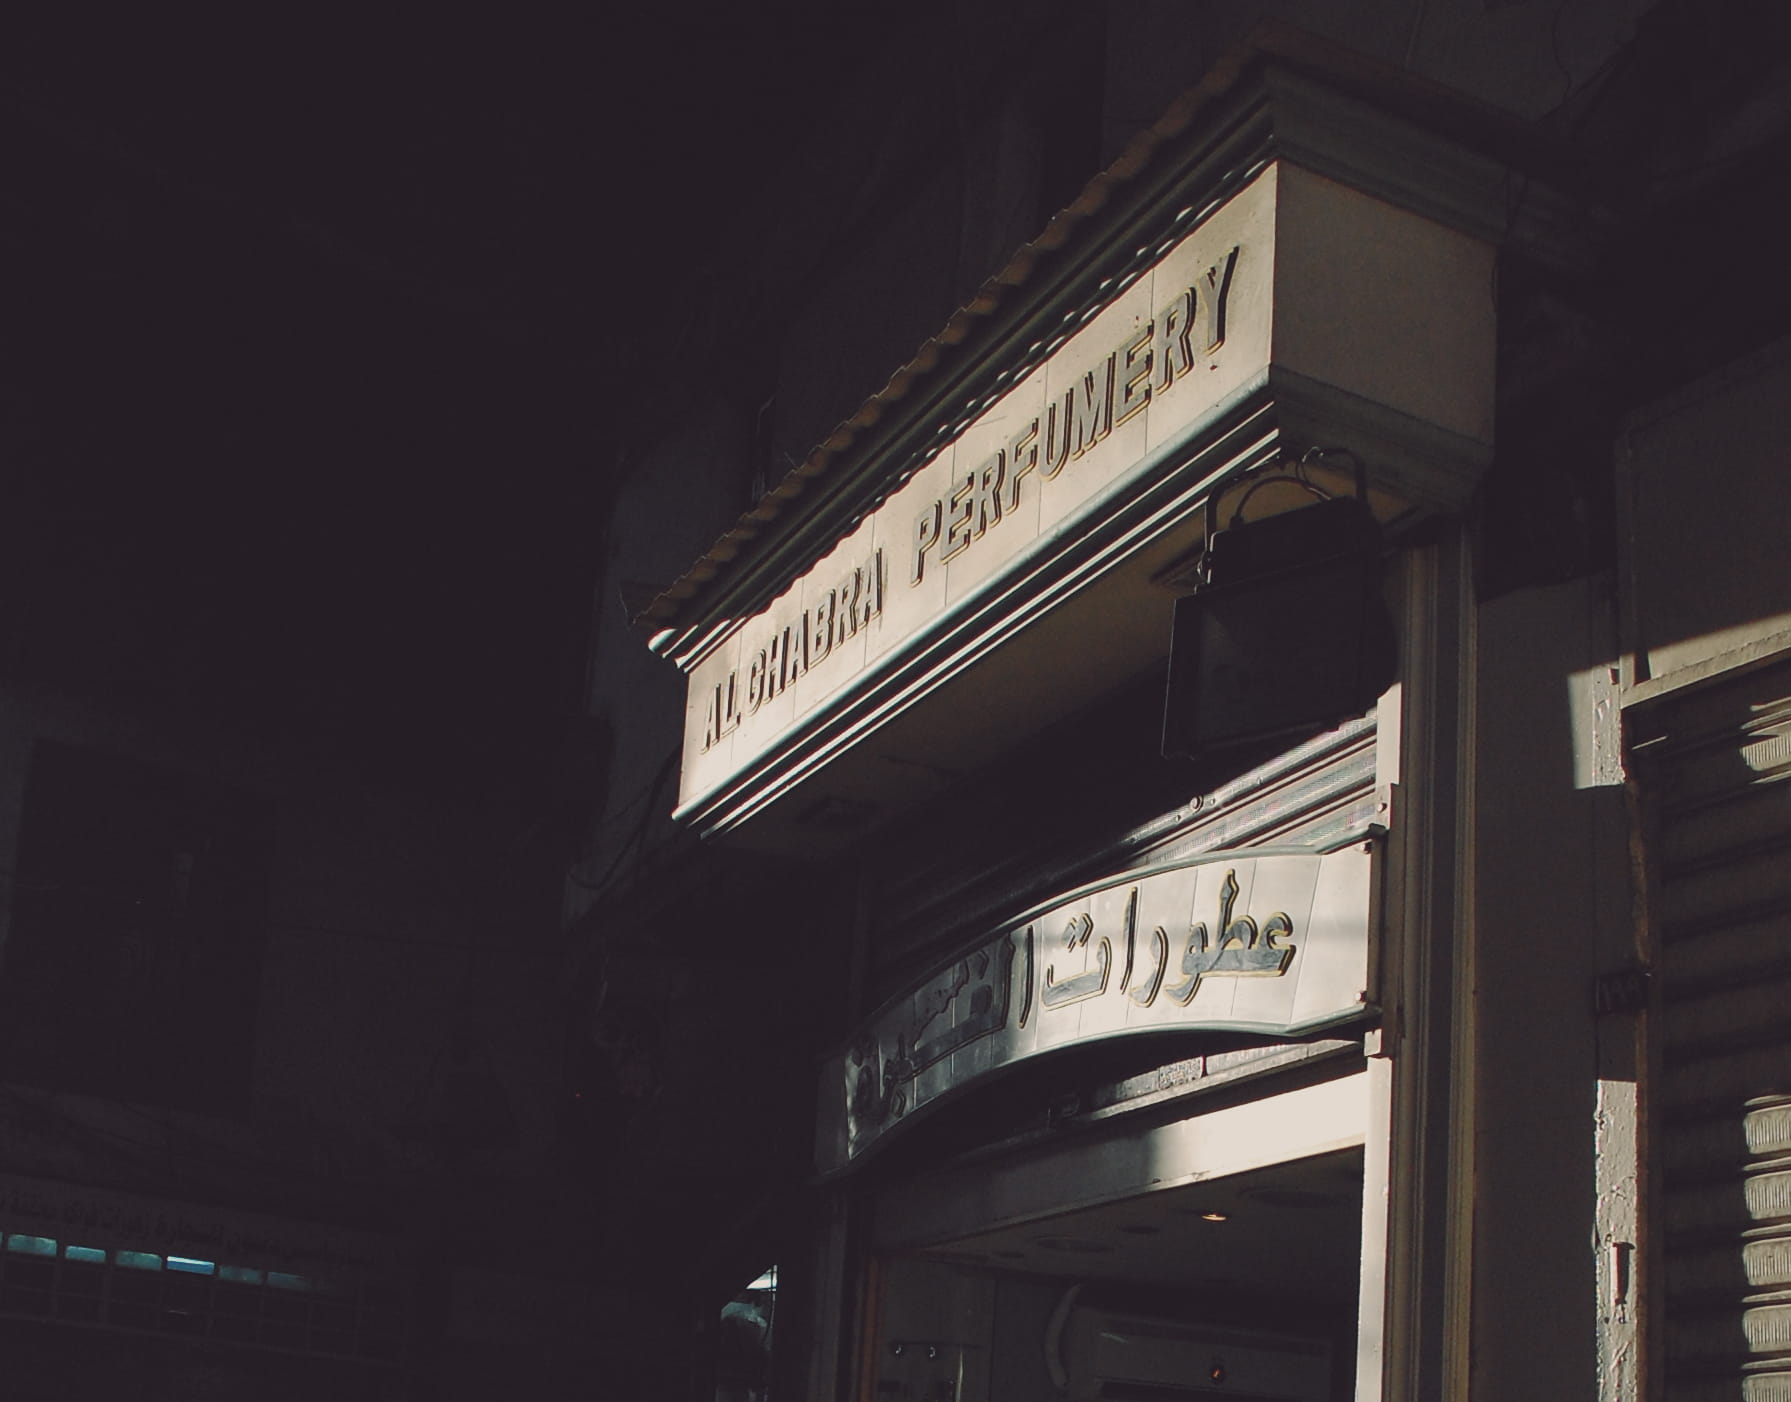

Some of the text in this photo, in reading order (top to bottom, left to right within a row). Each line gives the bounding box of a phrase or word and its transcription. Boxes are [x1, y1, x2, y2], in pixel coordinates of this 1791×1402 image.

[699, 245, 1240, 756] AL GHABRA PERFUMERY
[1041, 868, 1297, 1009] عطورات
